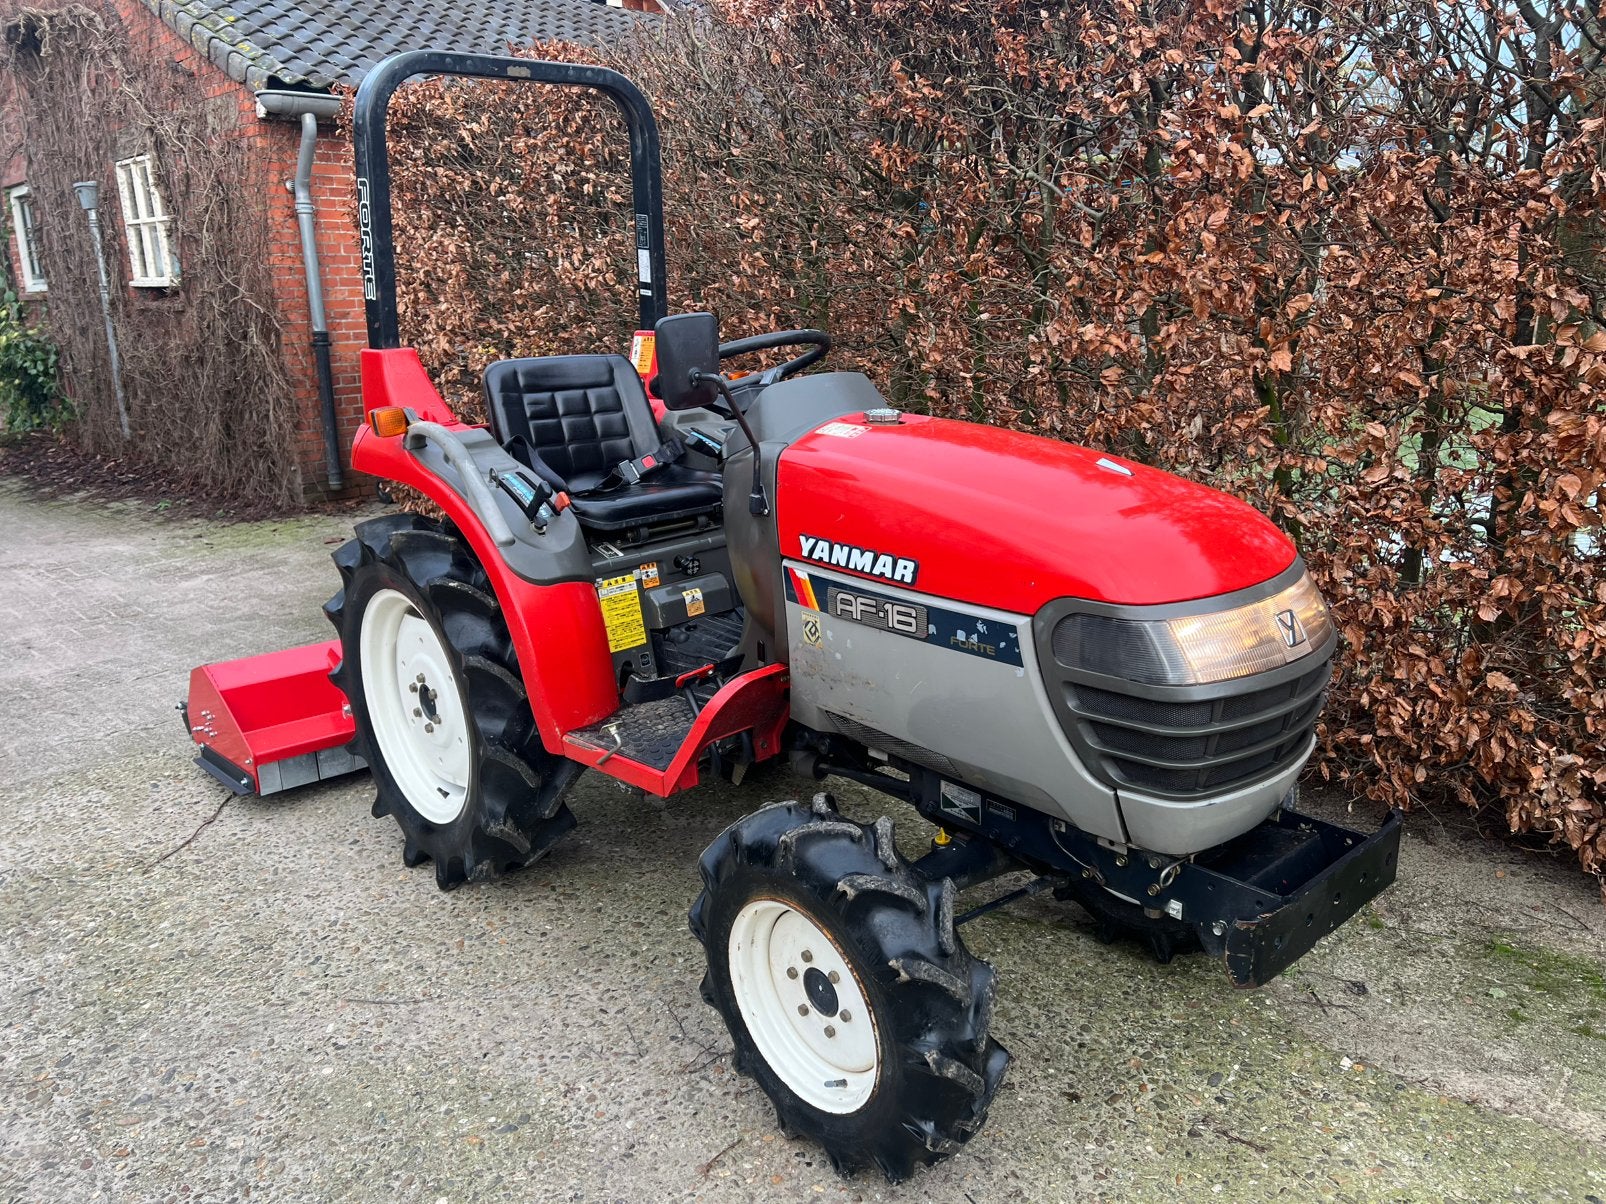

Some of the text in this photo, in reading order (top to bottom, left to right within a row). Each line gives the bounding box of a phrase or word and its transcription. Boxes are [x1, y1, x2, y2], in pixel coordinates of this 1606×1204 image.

[357, 178, 377, 301] FORTE
[800, 535, 917, 584] YANMAR
[950, 636, 996, 656] FORTE
